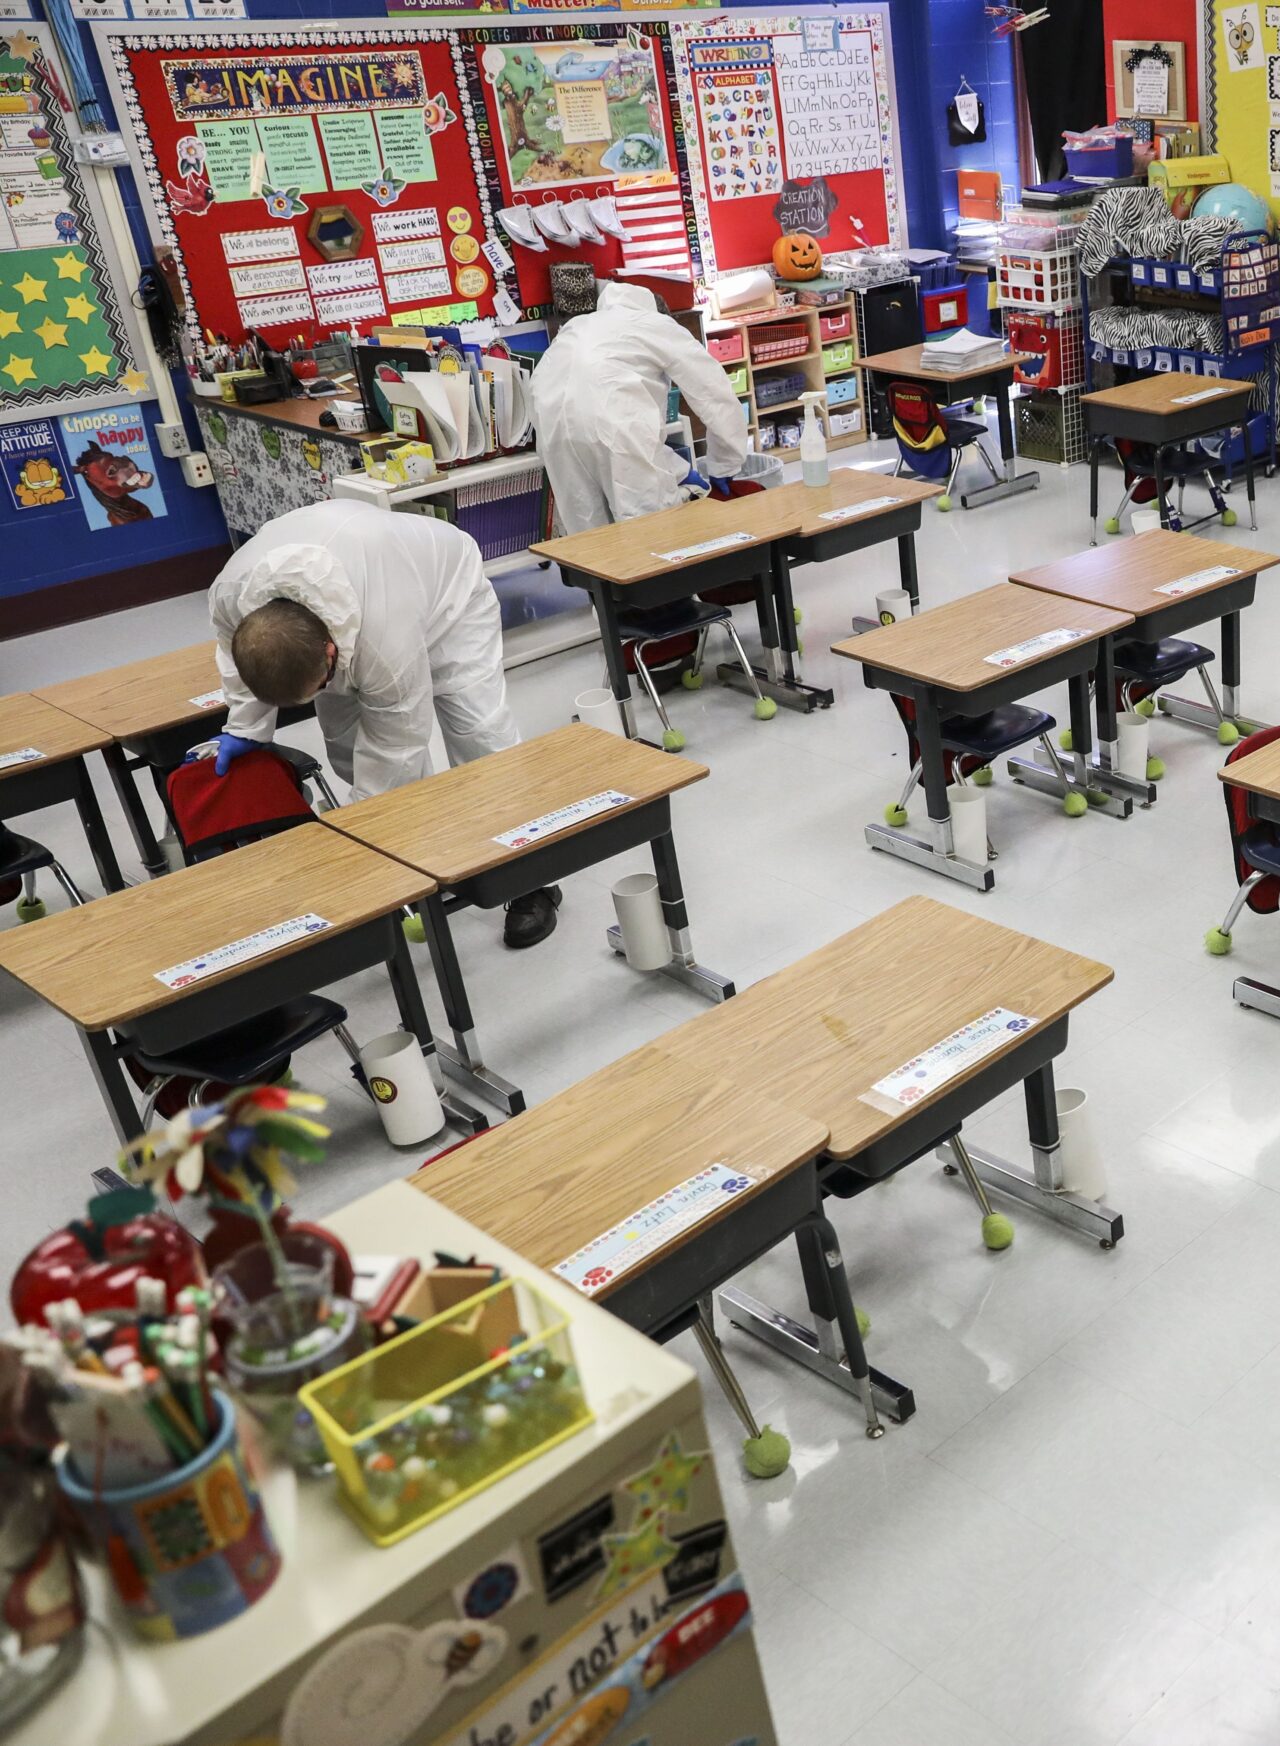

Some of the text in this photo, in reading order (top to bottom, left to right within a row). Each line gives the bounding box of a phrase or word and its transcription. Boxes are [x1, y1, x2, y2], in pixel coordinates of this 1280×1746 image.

[699, 46, 763, 63] WRITING
[221, 62, 387, 107] IMAGINE
[715, 73, 755, 86] ALPHABET
[558, 86, 571, 94] The
[229, 126, 250, 136] YOU
[782, 188, 825, 204] CREATION
[781, 207, 825, 225] STATION
[393, 220, 417, 230] work
[255, 237, 289, 247] belong
[484, 241, 505, 269] have
[253, 267, 299, 280] encourage
[328, 274, 341, 284] try
[276, 304, 294, 316] give
[22, 423, 49, 434] YOUR
[63, 411, 119, 434] Choose
[1, 431, 54, 453] ATTITUDE
[97, 427, 144, 447] happy
[642, 1182, 719, 1229] Gavin Lutz
[529, 1685, 558, 1726] or
[568, 1622, 623, 1695] not
